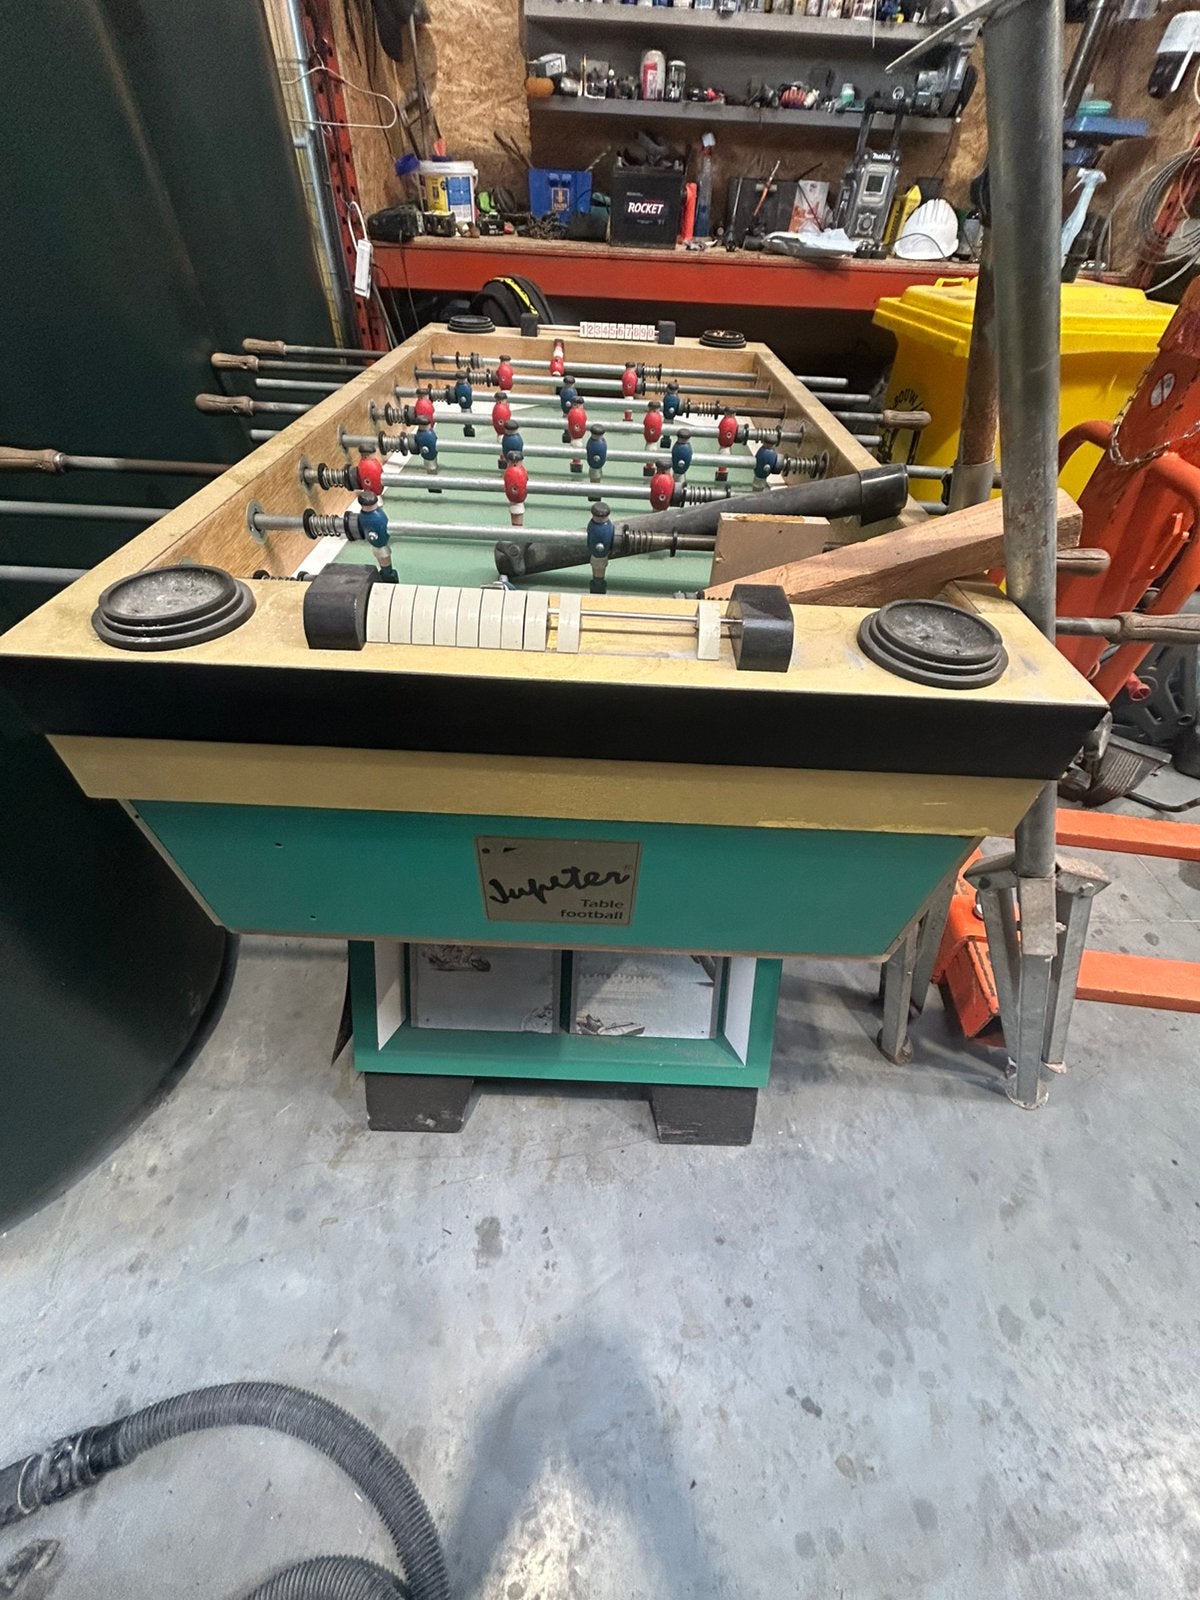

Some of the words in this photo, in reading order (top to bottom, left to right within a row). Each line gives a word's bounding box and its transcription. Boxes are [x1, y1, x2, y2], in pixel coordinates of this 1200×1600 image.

[627, 202, 664, 215] ROCKET
[580, 899, 624, 909] Table
[560, 909, 623, 919] football
